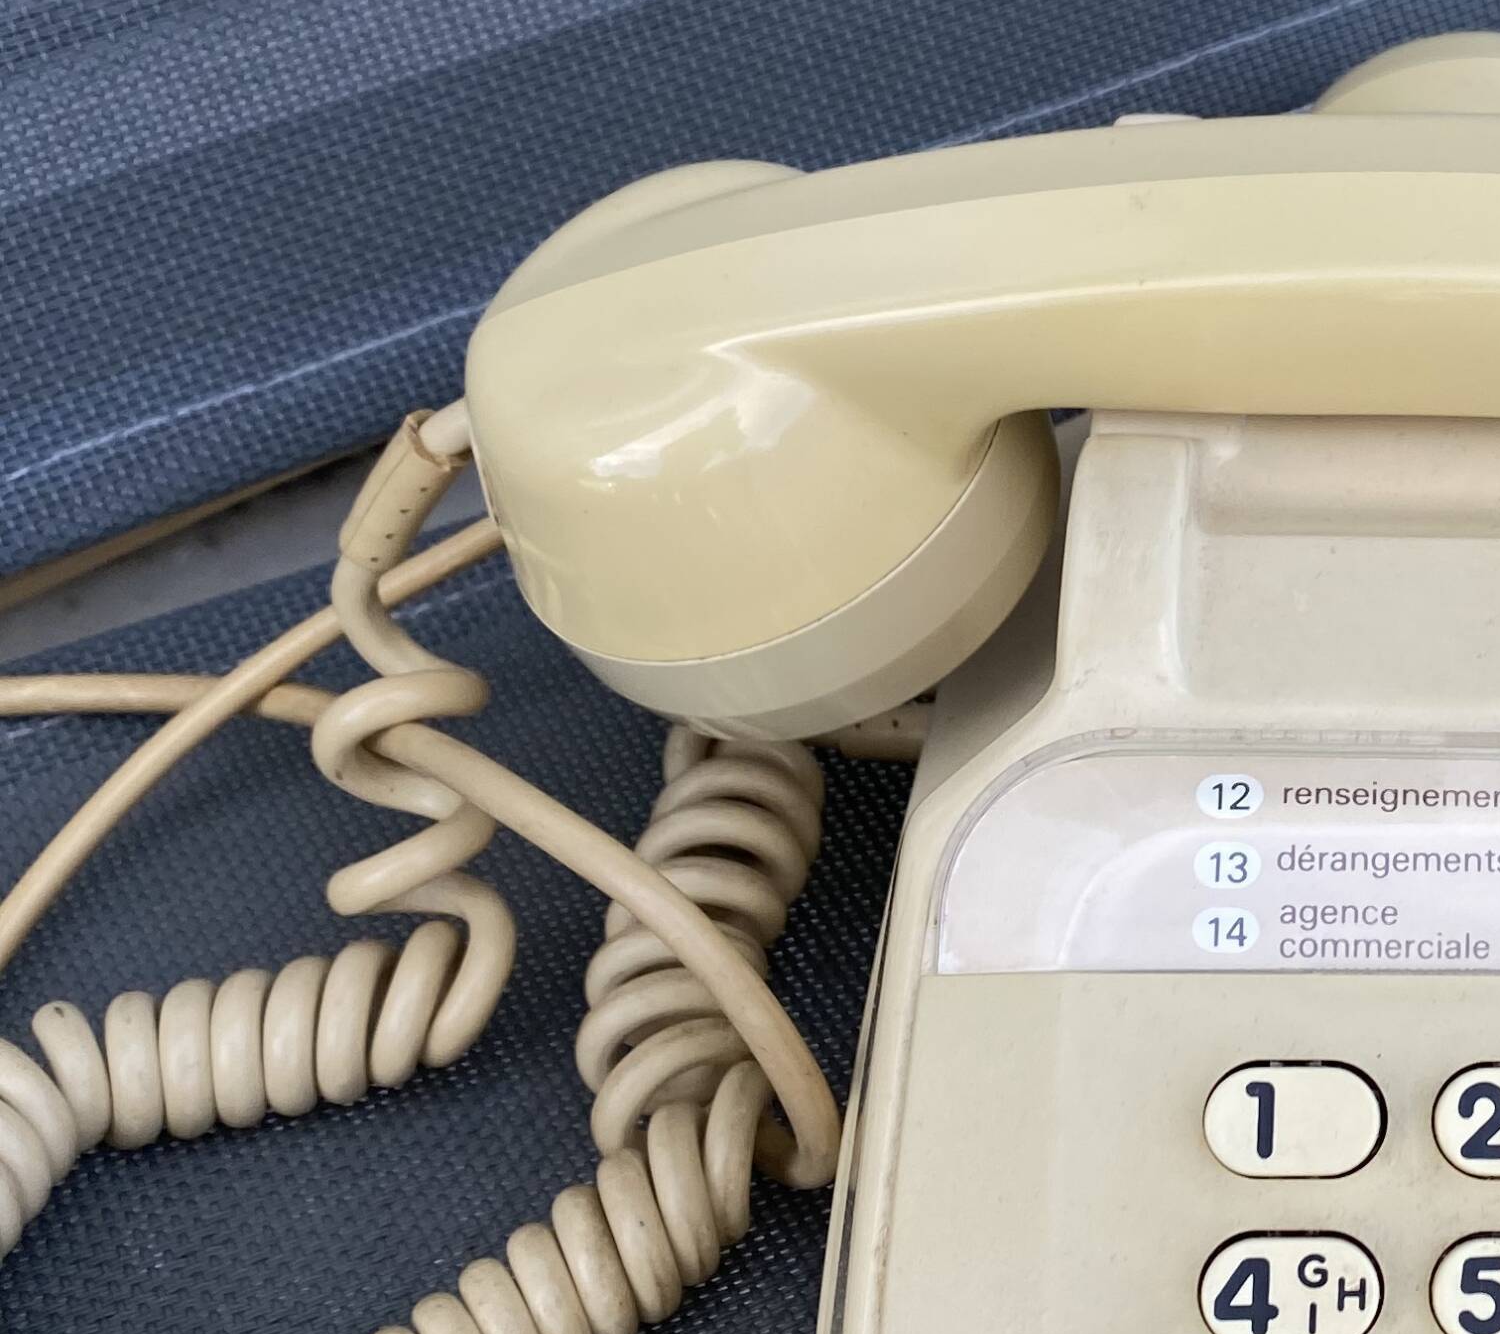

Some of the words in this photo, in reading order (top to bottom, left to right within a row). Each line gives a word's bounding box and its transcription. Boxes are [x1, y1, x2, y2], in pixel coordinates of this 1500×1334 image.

[1211, 781, 1251, 811] 12
[1209, 851, 1248, 884] 13
[1207, 916, 1248, 948] 14
[1279, 903, 1399, 930] agence
[1279, 932, 1491, 960] commerciale
[1246, 1082, 1275, 1159] 1
